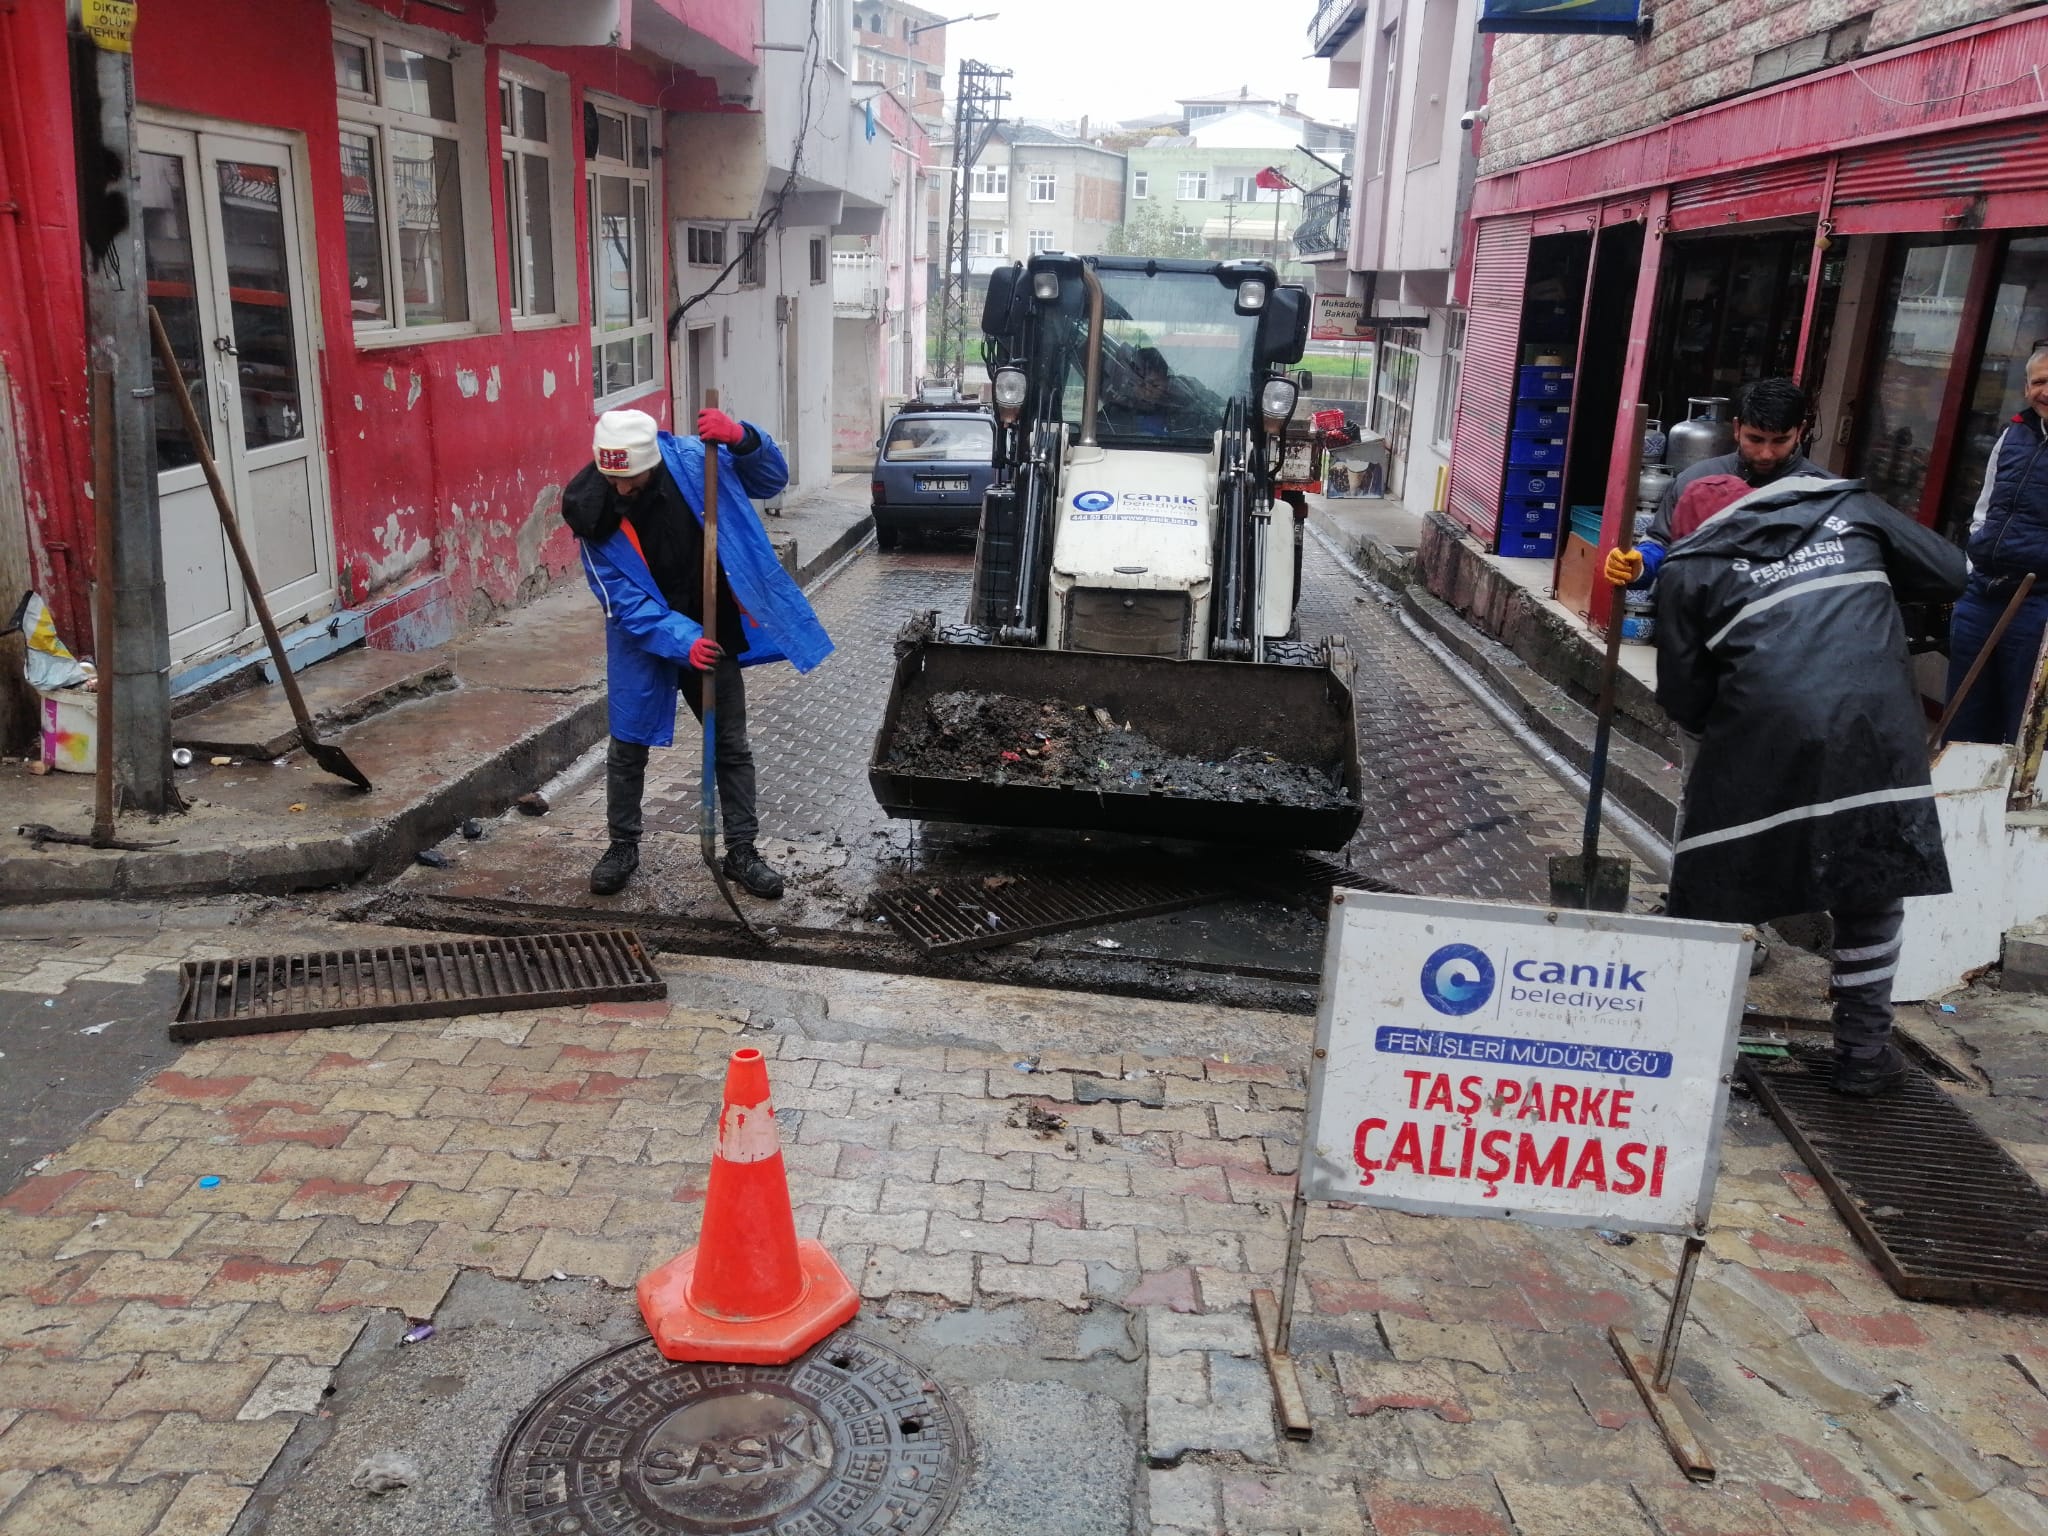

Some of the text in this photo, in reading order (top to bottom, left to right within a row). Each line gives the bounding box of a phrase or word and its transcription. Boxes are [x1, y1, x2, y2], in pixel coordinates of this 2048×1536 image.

[1121, 500, 1198, 512] belediyesi
[1123, 492, 1198, 506] canik
[1120, 515, 1196, 526] www.canik.bel.tr
[1750, 560, 1786, 584] FEN
[1512, 958, 1648, 993] canik
[1510, 985, 1645, 1013] belediyesi
[1387, 1031, 1659, 1074] FEN İŞLERİ MÜDÜRLÜĞÜ
[1403, 1069, 1636, 1129] TAŞ PARKE
[1352, 1117, 1669, 1199] ÇALIŞMASI
